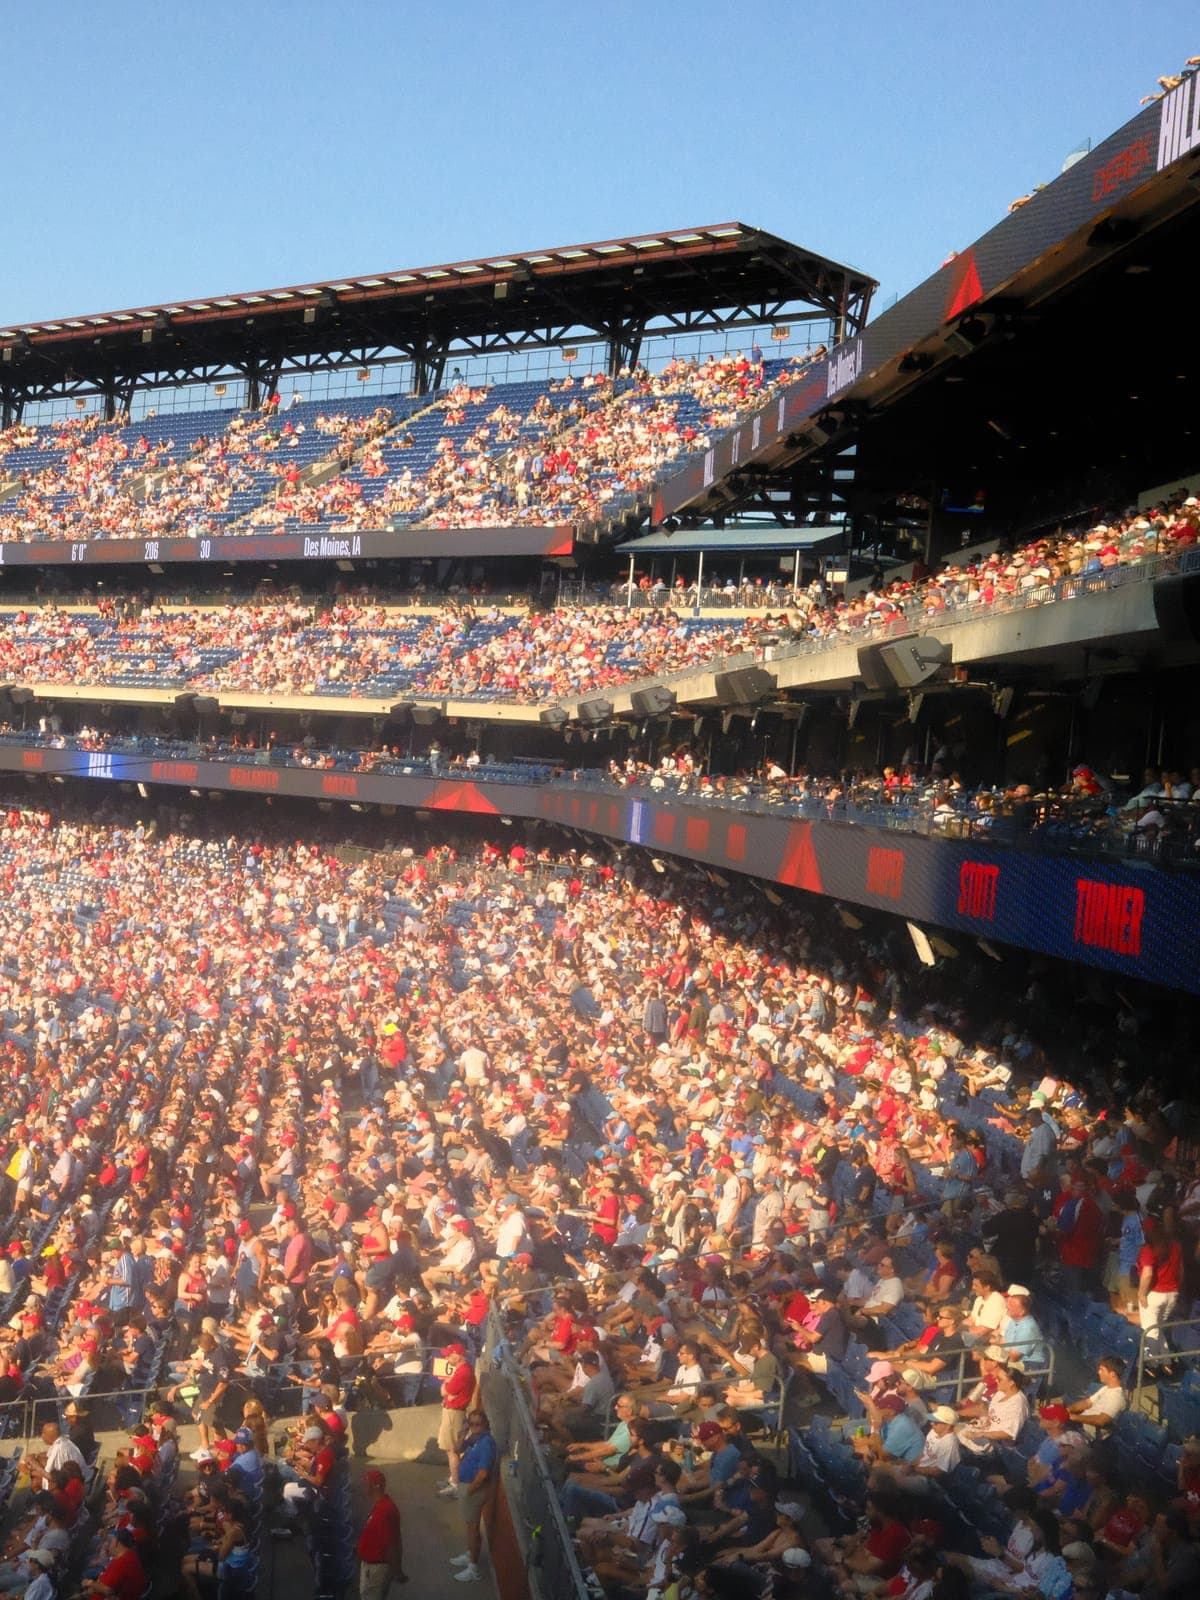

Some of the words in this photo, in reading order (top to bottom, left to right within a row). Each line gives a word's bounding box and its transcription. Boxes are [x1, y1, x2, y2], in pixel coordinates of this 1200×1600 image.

[144, 542, 159, 560] 206
[200, 540, 211, 559] 30
[304, 537, 319, 557] Des
[319, 536, 351, 558] Moines,
[351, 535, 361, 556] IA
[88, 752, 113, 778] HILL
[957, 860, 1000, 922] STOTT
[1074, 878, 1145, 957] TURNER
